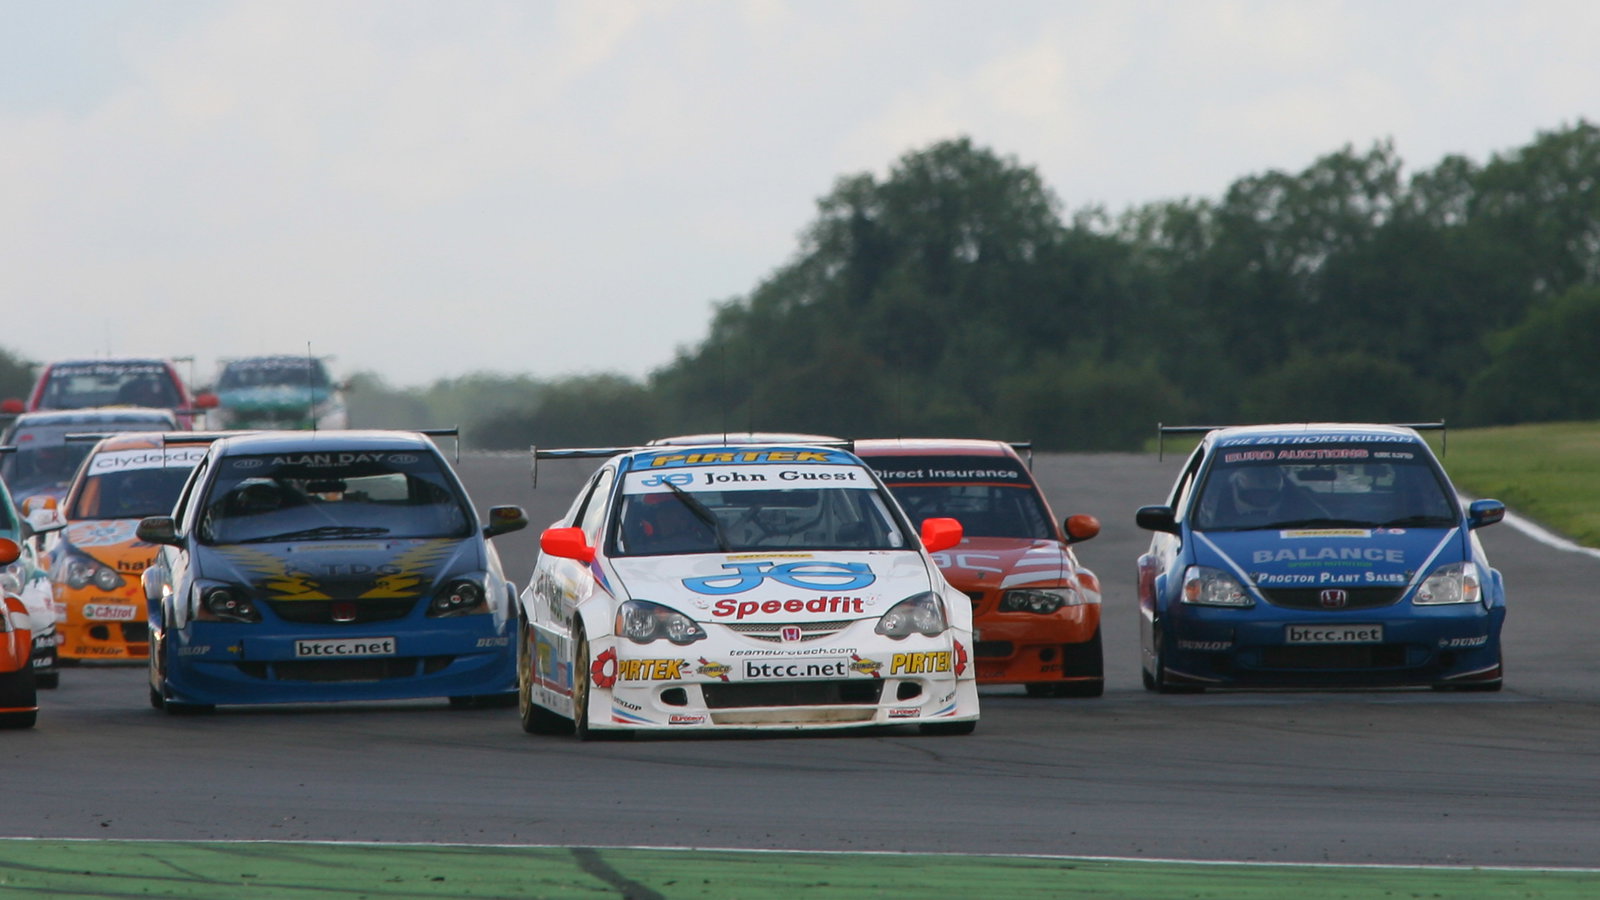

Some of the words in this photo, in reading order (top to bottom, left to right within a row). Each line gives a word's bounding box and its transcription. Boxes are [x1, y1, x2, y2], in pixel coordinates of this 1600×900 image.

[1223, 438, 1250, 446] THE
[1293, 435, 1346, 443] HORSE
[1350, 435, 1414, 443] KILHAM
[271, 454, 331, 464] ALAN
[338, 453, 384, 462] DAY
[651, 451, 834, 466] PIRTEK
[1225, 451, 1274, 462] EURO
[1278, 449, 1369, 459] AUCTIONS
[705, 472, 767, 484] John
[779, 471, 857, 481] Guest
[873, 469, 924, 478] Direct
[929, 469, 1018, 479] Insurance
[1253, 548, 1405, 563] BALANCE
[1320, 572, 1360, 583] PLANT
[1365, 571, 1405, 582] SALES
[95, 607, 133, 618] Castrol
[711, 596, 864, 620] Speedfit
[1290, 628, 1380, 641] btcc.net
[75, 647, 123, 655] DUNLOP
[298, 641, 392, 655] btcc.net
[729, 647, 858, 657] teameurotech.com
[618, 658, 685, 681] PIRTEK
[698, 664, 732, 674] SUNOCO
[746, 660, 846, 678] btcc.net
